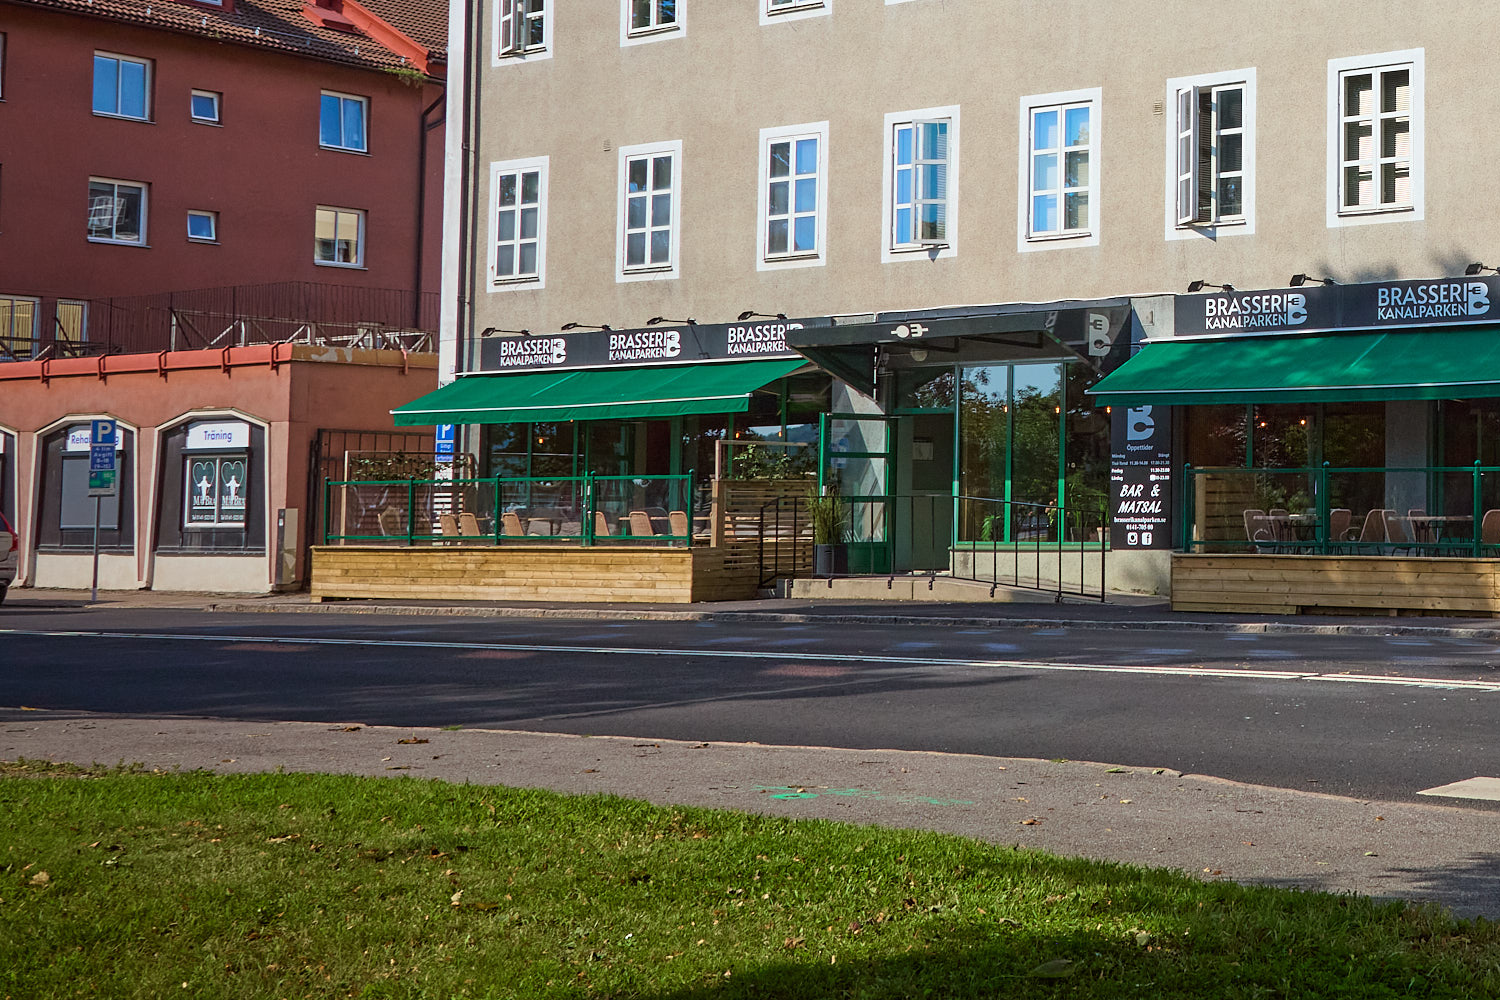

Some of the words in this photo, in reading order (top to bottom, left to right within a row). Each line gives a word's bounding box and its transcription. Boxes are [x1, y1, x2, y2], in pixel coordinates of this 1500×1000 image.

[1378, 303, 1467, 320] KANALPARKEN
[1205, 313, 1287, 329] KANALPARKEN
[500, 354, 553, 367] KANALPARKEN
[609, 348, 666, 360] KANALPARKEN
[97, 421, 112, 442] P
[203, 429, 233, 443] Träning
[1126, 443, 1154, 452] Öppettider
[1119, 484, 1144, 498] BAR
[1150, 483, 1161, 498] &
[1117, 500, 1162, 514] MATSAL
